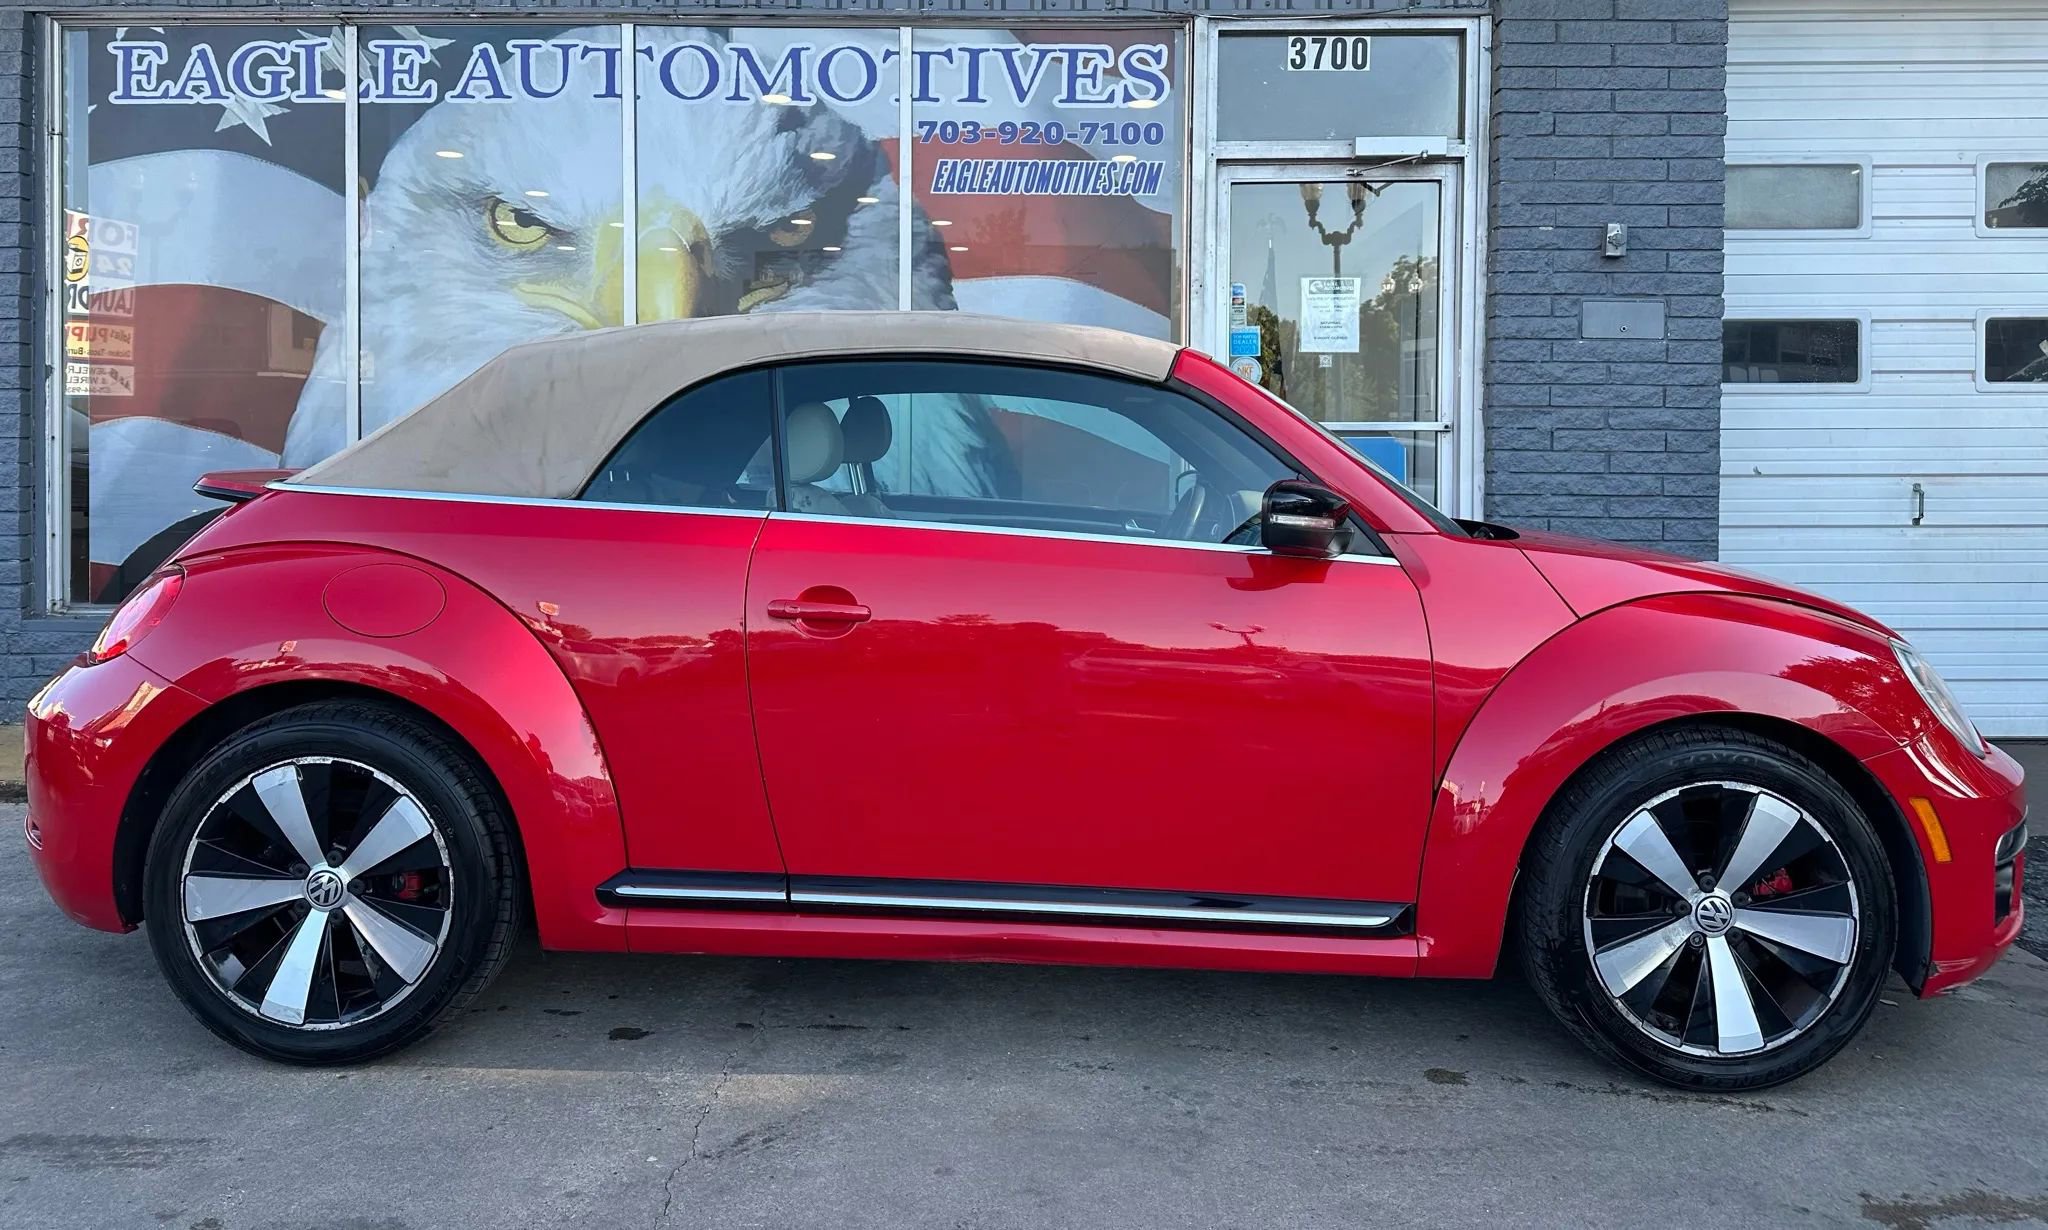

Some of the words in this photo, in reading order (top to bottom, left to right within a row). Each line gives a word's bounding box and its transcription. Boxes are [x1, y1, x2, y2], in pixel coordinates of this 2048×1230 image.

[1290, 37, 1368, 70] 3700
[108, 41, 435, 103] EAGLE
[446, 40, 1169, 106] AUTOMOTIVES
[918, 120, 1164, 145] 703-920-7100
[931, 158, 1165, 196] EAGLEAUTOMOTIVES.COM
